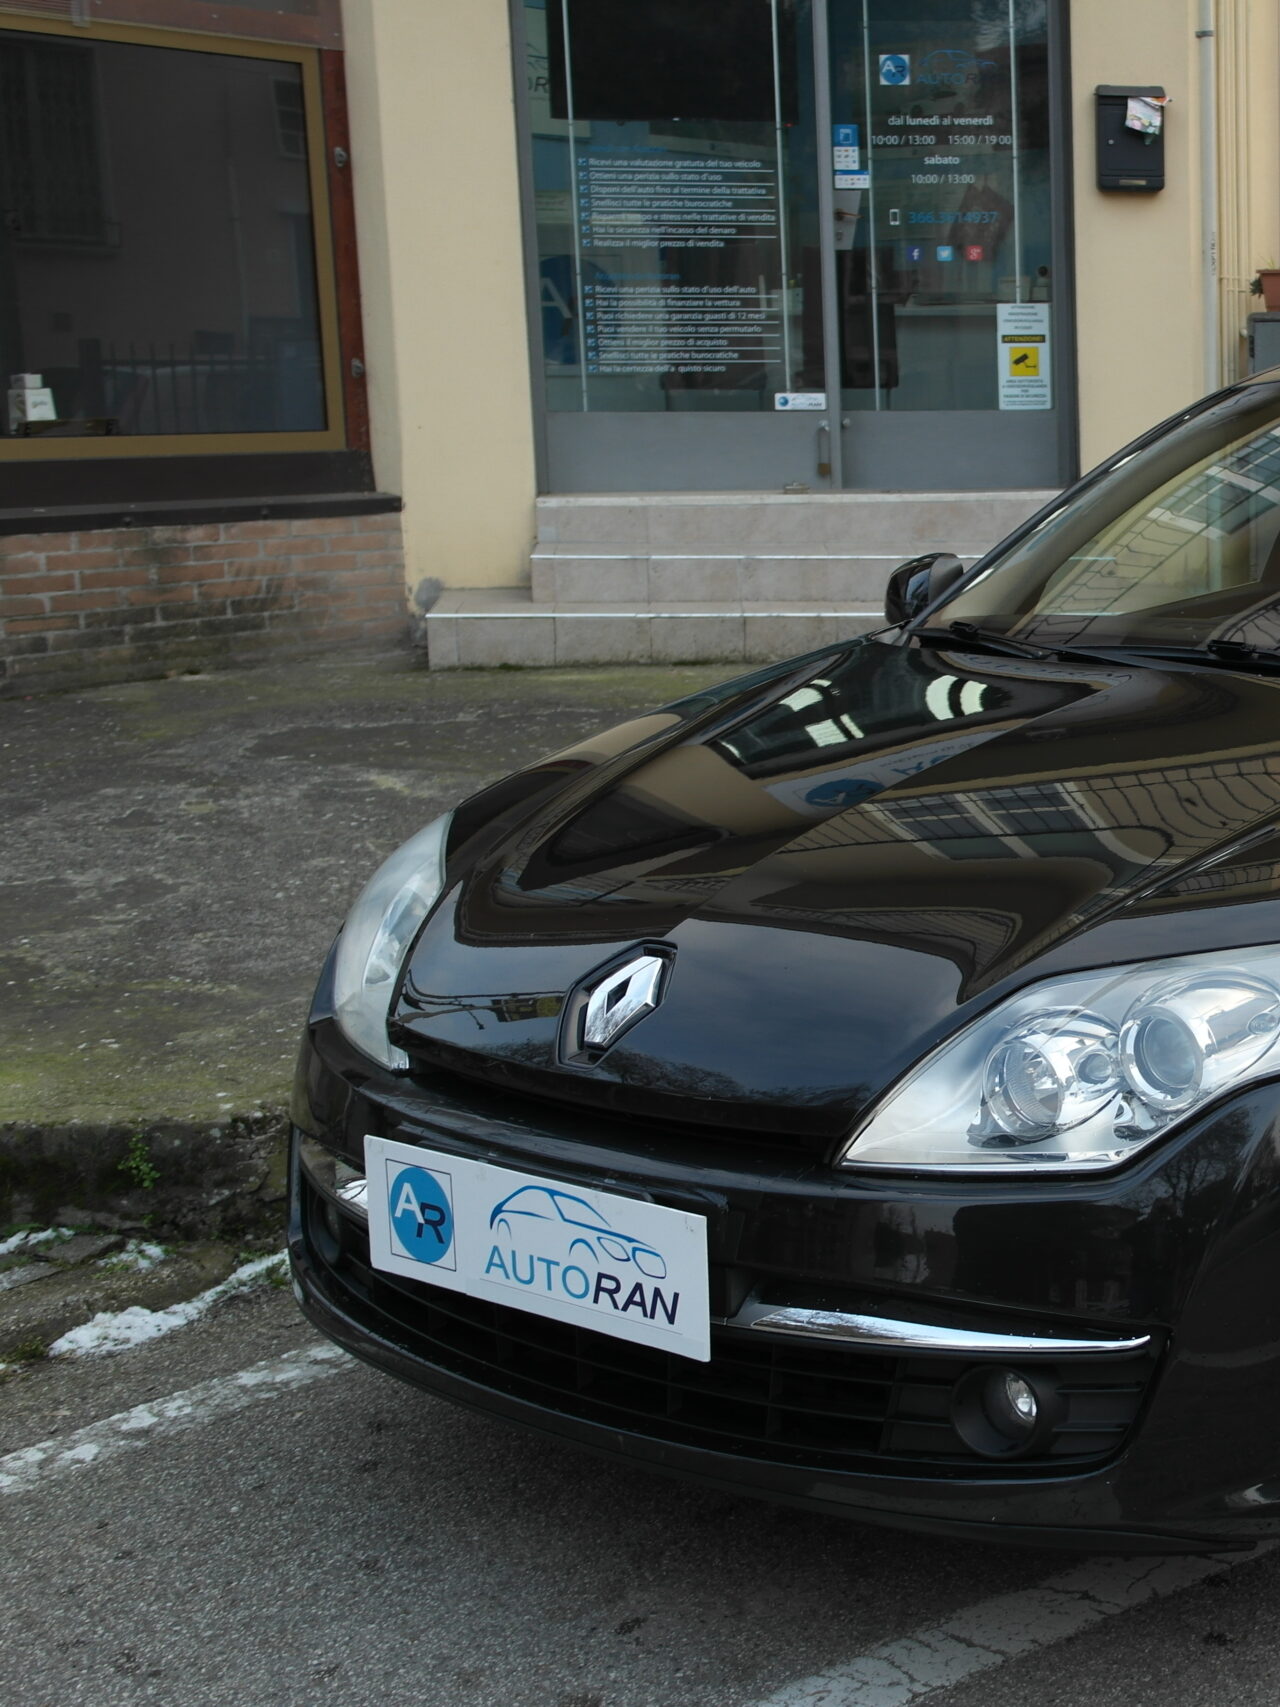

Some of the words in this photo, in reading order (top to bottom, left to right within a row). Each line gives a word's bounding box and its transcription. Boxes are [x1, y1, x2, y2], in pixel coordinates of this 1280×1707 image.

[881, 60, 906, 78] AR
[888, 115, 903, 126] dal
[942, 115, 951, 126] al
[924, 155, 960, 165] sabato
[911, 174, 938, 184] 10:00
[948, 174, 975, 184] 13:00
[394, 1182, 446, 1245] AR
[485, 1245, 680, 1325] AUTORAN
